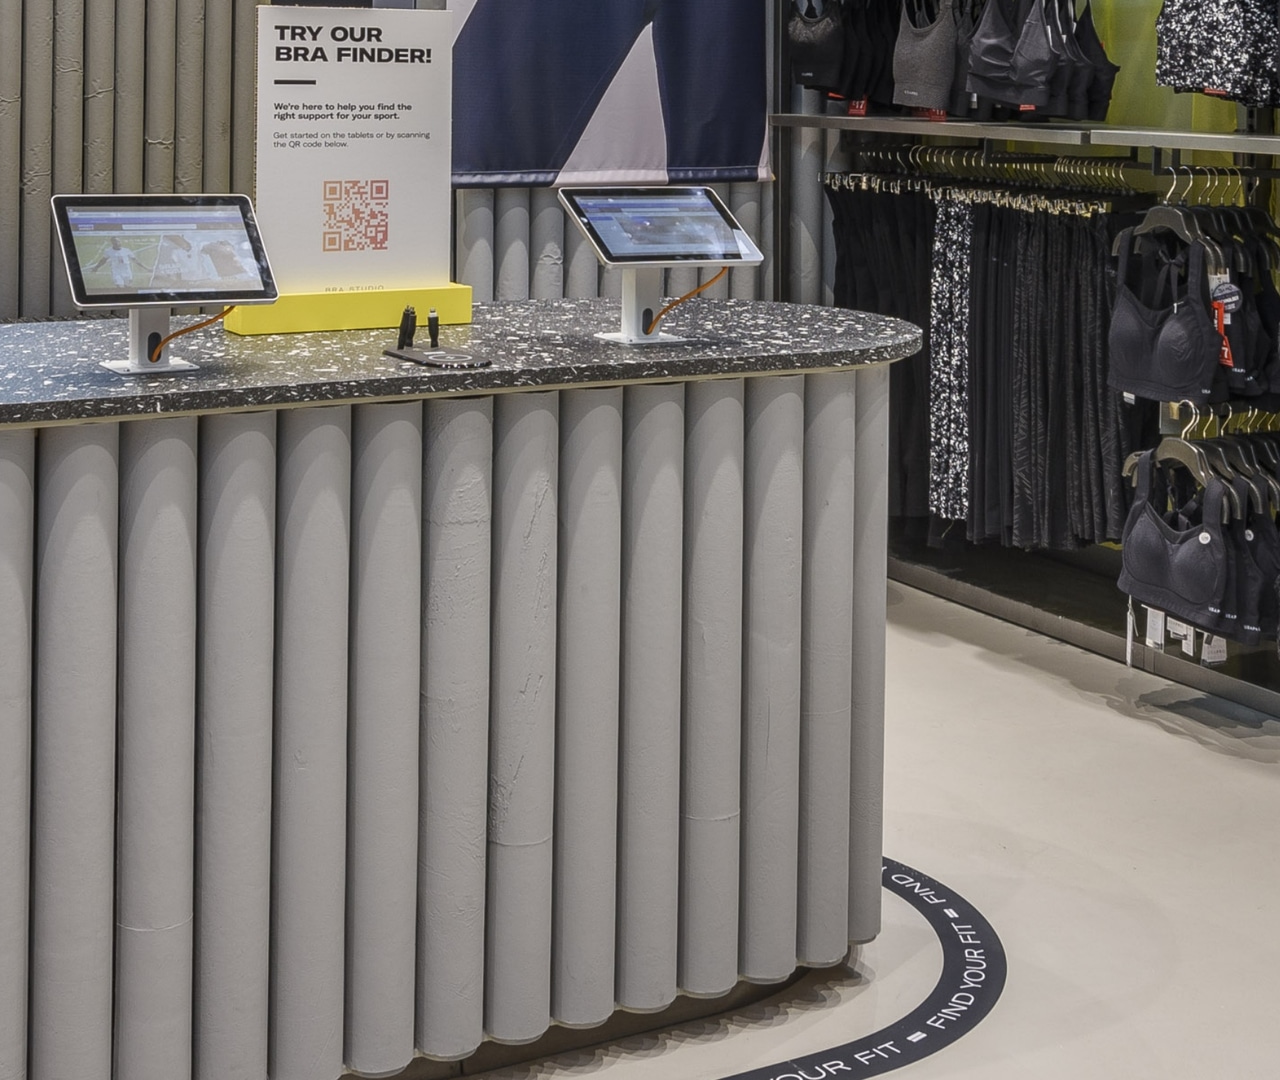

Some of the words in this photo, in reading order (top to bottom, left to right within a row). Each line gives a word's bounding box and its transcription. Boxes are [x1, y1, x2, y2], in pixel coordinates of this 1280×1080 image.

[274, 25, 323, 42] TRY
[330, 26, 383, 42] OUR
[275, 46, 328, 62] BRA
[336, 47, 432, 63] FINDER!
[274, 102, 300, 111] We're
[302, 103, 323, 111] here
[337, 103, 357, 112] help
[377, 103, 395, 111] find
[397, 103, 413, 111] the
[273, 111, 295, 121] right
[298, 112, 334, 121] support
[336, 111, 350, 120] for
[352, 113, 372, 121] your
[374, 112, 401, 121] sport.
[273, 132, 288, 140] Get
[290, 131, 319, 139] started
[333, 131, 346, 139] the
[347, 131, 374, 139] tablets
[386, 131, 395, 140] by
[396, 131, 431, 140] scanning
[273, 140, 287, 148] the
[288, 140, 301, 149] QR
[302, 140, 322, 148] code
[324, 140, 349, 148] below.
[891, 874, 947, 904] FIND
[951, 922, 982, 944] FIT
[959, 949, 987, 989] YOUR
[926, 992, 975, 1030] FIND
[770, 1060, 852, 1080] OUR
[853, 1041, 901, 1065] FIT
